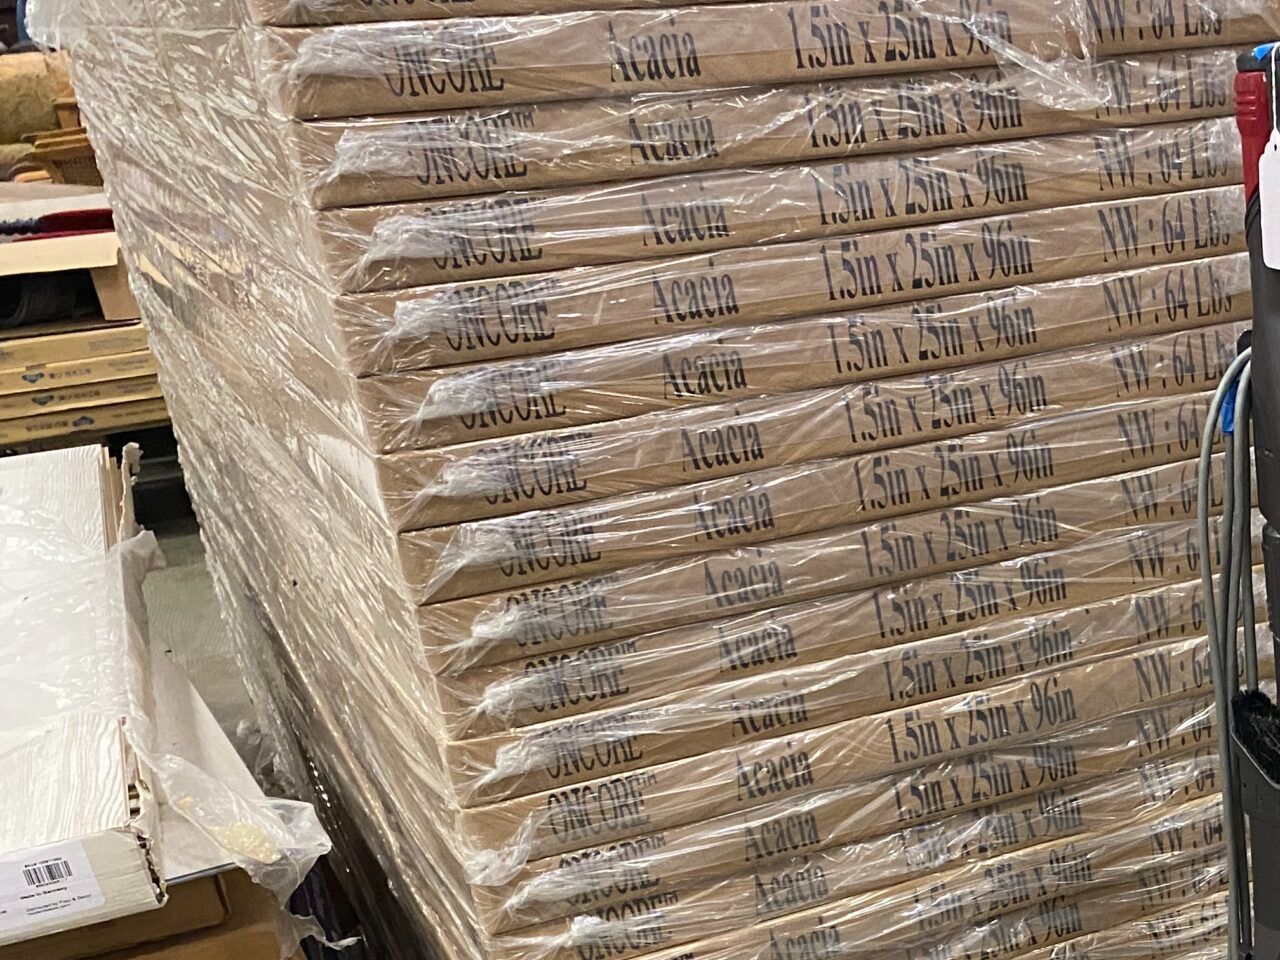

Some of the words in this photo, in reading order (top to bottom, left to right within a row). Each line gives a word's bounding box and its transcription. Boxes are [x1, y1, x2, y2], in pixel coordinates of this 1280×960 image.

[608, 19, 701, 83] Acacia
[629, 101, 719, 165] Acacia
[642, 174, 729, 246] Acacia
[652, 256, 739, 324] Acacia
[820, 239, 881, 300] 1.5in
[905, 232, 958, 289] 25in
[982, 220, 1034, 275] 96in
[1098, 205, 1140, 262] NW
[1162, 210, 1187, 254] 64
[1193, 196, 1230, 249] Lbs
[662, 339, 747, 400] Acacia
[827, 314, 888, 373] 1.5in
[912, 303, 964, 361] 25in
[988, 294, 1037, 348] 96in
[1102, 277, 1144, 331] NW
[1165, 281, 1189, 323] 64
[1195, 260, 1233, 317] Lbs
[681, 411, 764, 472] Acacia
[693, 481, 774, 542] Acacia
[854, 455, 908, 512] 1.5in
[934, 445, 984, 497] 25in
[1005, 430, 1055, 480] 96in
[704, 548, 783, 609] Acacia
[860, 524, 918, 578] 1.5in
[940, 509, 989, 562] 25in
[1008, 497, 1059, 545] 96in
[718, 611, 798, 674] Acacia
[737, 741, 814, 802] Acacia
[885, 713, 941, 765] 1.5in
[965, 698, 1010, 747] 25in
[1030, 680, 1077, 729] 96in
[744, 798, 821, 863] Acacia
